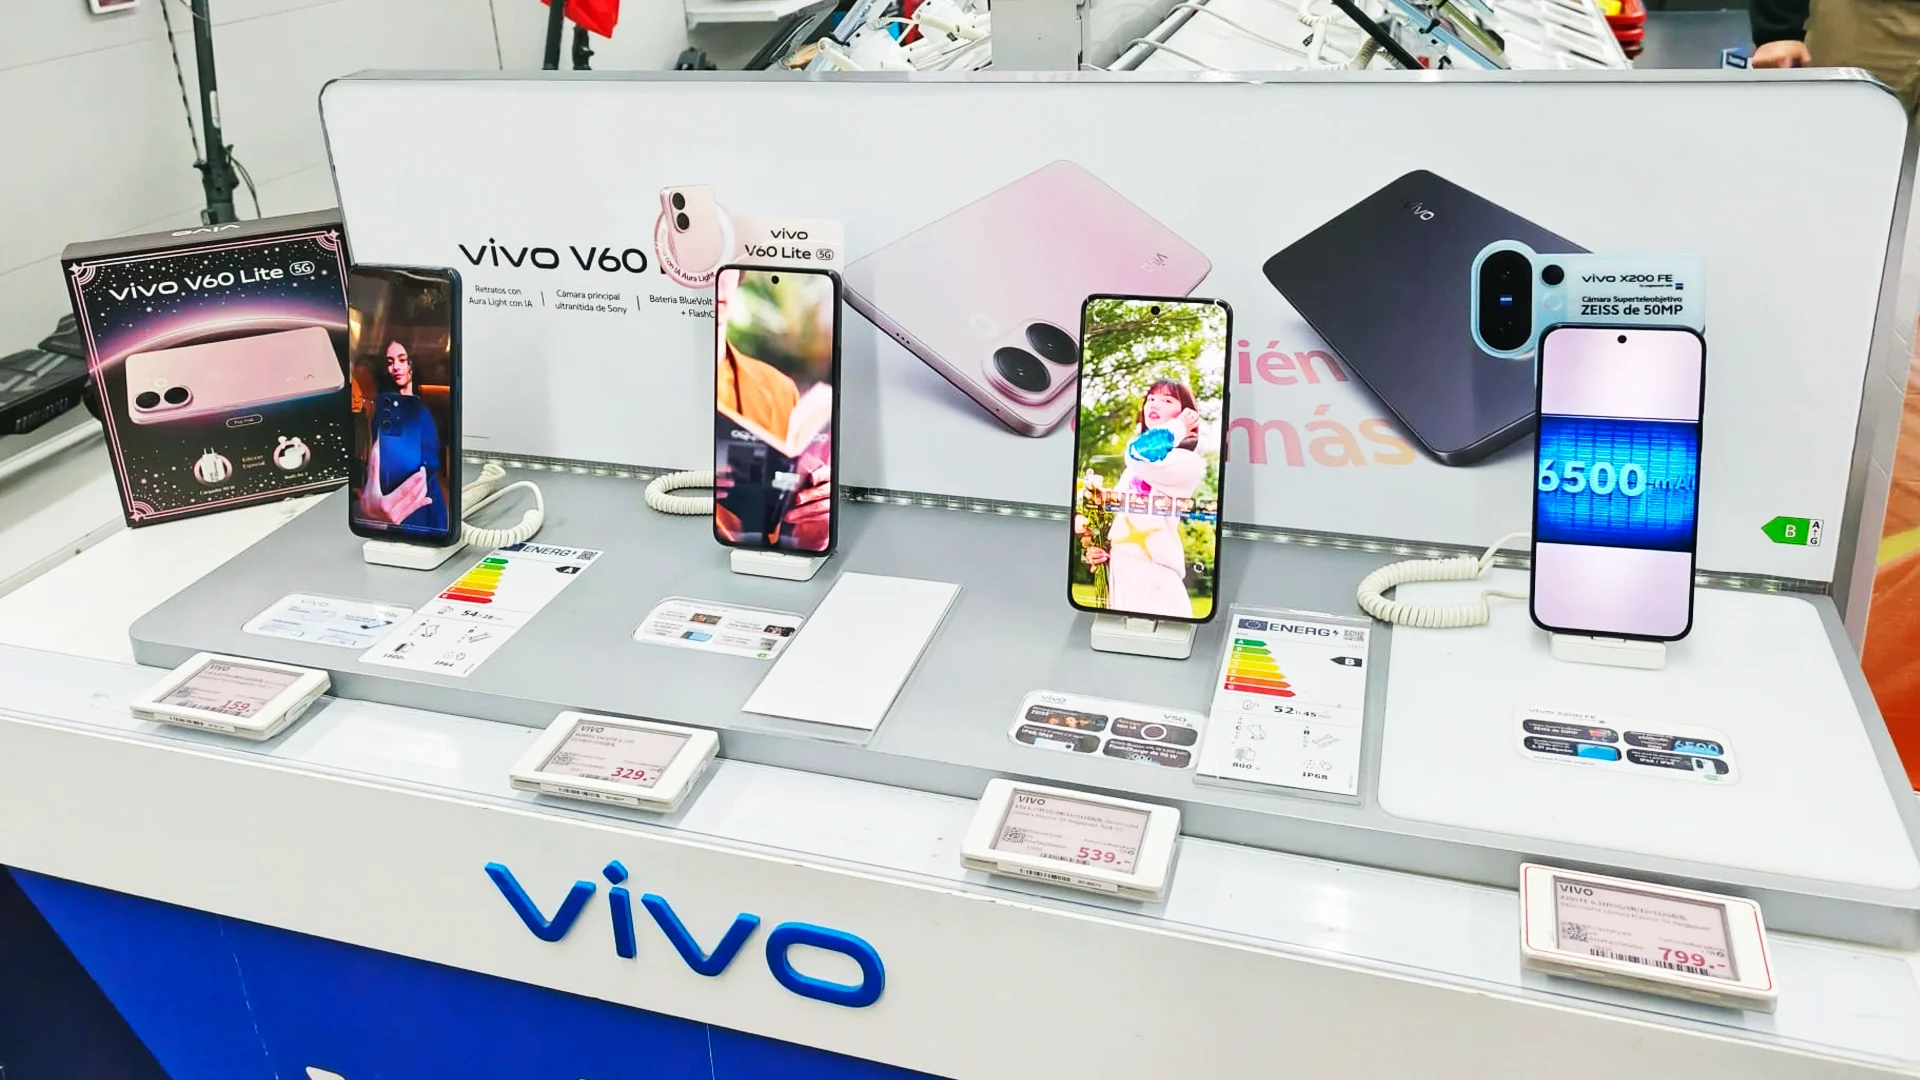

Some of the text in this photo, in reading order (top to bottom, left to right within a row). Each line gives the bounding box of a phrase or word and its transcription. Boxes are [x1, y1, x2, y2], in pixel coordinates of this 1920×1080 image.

[1402, 201, 1435, 221] ivo
[771, 228, 808, 240] vivo
[459, 237, 648, 274] vivo V60
[745, 244, 833, 260] V60 Lite 5G
[109, 261, 313, 301] vivo V60 Lite 5G
[681, 272, 698, 282] Aura
[698, 271, 715, 282] Light
[1581, 274, 1673, 283] vivo X200 FE
[475, 284, 507, 295] Retratos
[587, 291, 621, 301] principal
[679, 296, 713, 306] BlueVolt
[1613, 295, 1683, 304] Superteleobjetivo
[469, 297, 487, 305] Aura
[488, 298, 508, 308] Light
[596, 304, 606, 312] de
[607, 304, 627, 315] Sony
[1581, 304, 1684, 315] ZEISS de 50MP
[1538, 458, 1646, 497] 6500
[1785, 524, 1796, 538] B
[1810, 537, 1819, 545] G
[523, 545, 571, 556] ENERG
[1269, 622, 1330, 637] ENERG
[1344, 658, 1355, 666] B
[1274, 705, 1294, 715] 52
[580, 725, 605, 733] VIVO
[1019, 795, 1046, 806] VIVO
[1077, 846, 1131, 865] 539.-
[1559, 884, 1594, 897] VIVO
[484, 859, 886, 1009] vivo
[1658, 946, 1726, 970] 799.-
